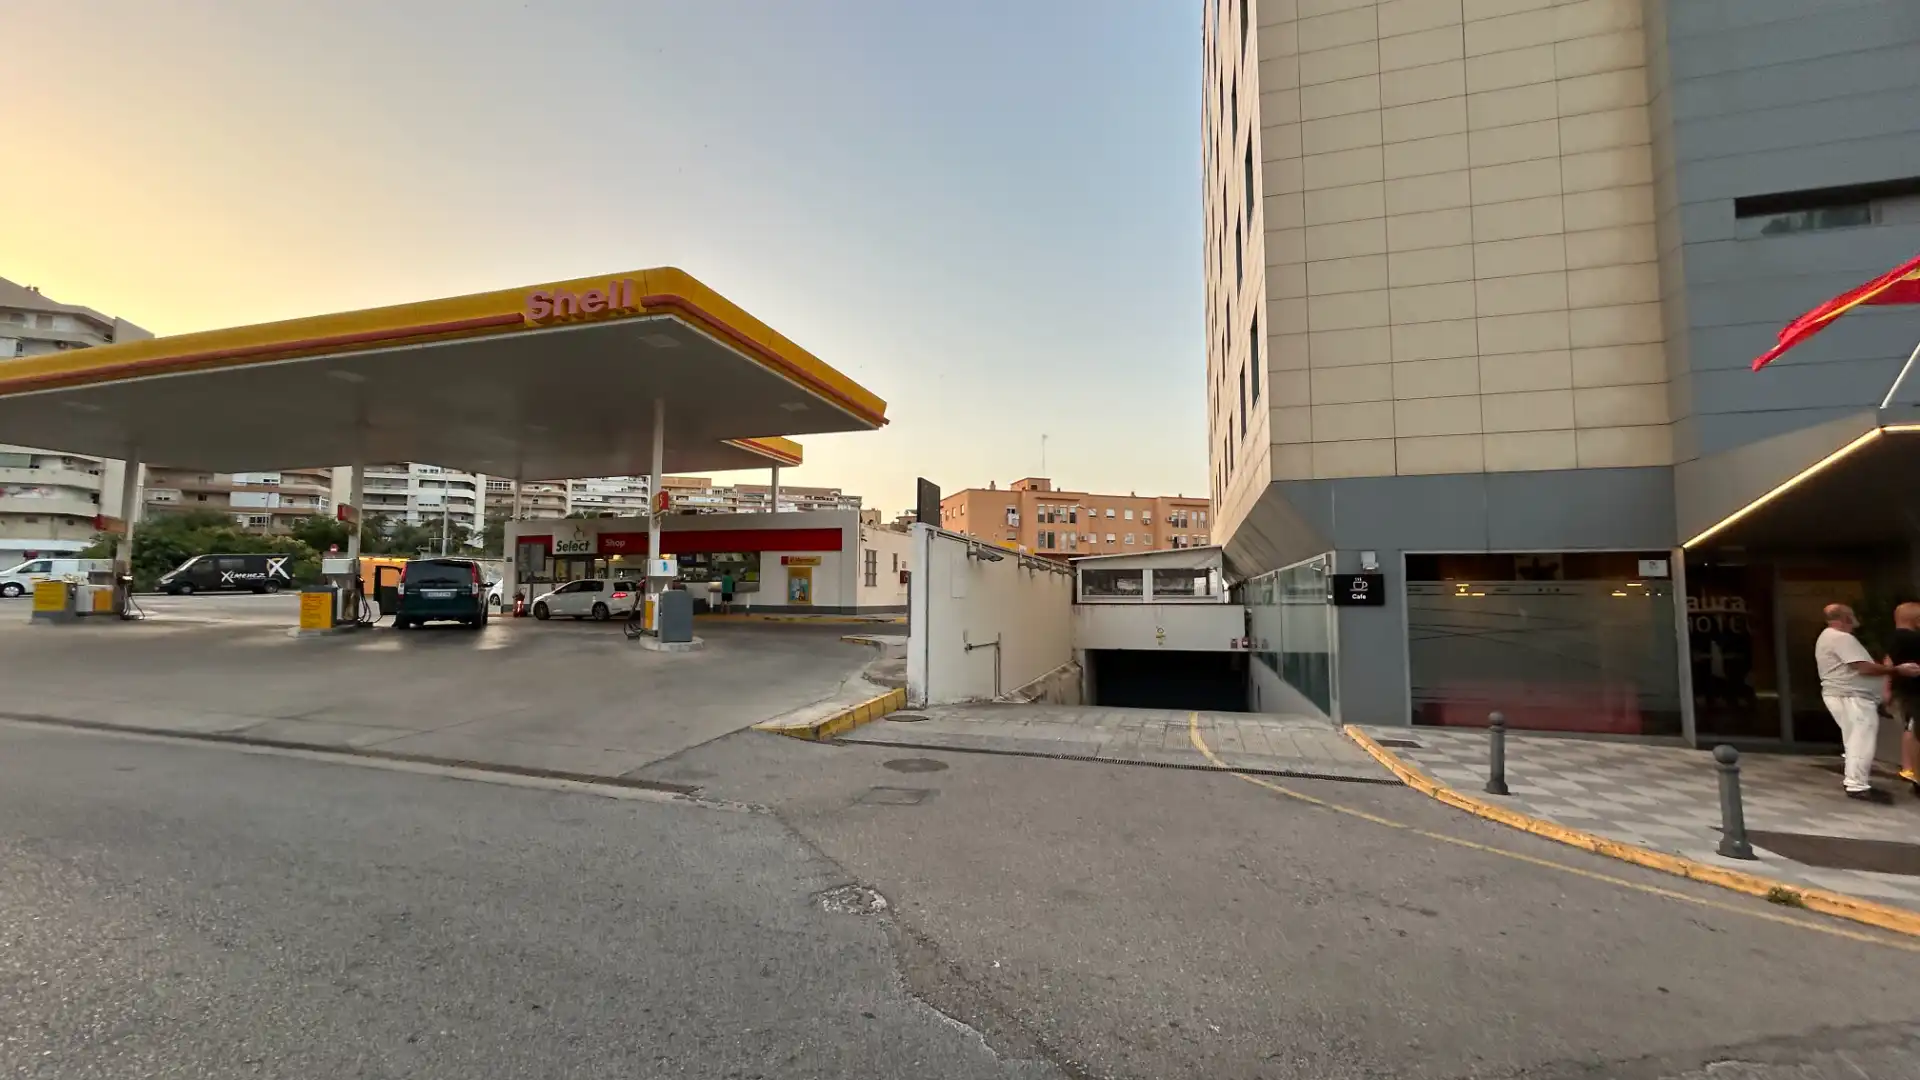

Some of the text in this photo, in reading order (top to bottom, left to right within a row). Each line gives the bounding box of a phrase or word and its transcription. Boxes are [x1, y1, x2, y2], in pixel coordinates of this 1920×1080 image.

[525, 279, 635, 320] Shell
[556, 540, 590, 552] Select
[605, 539, 626, 548] Shop
